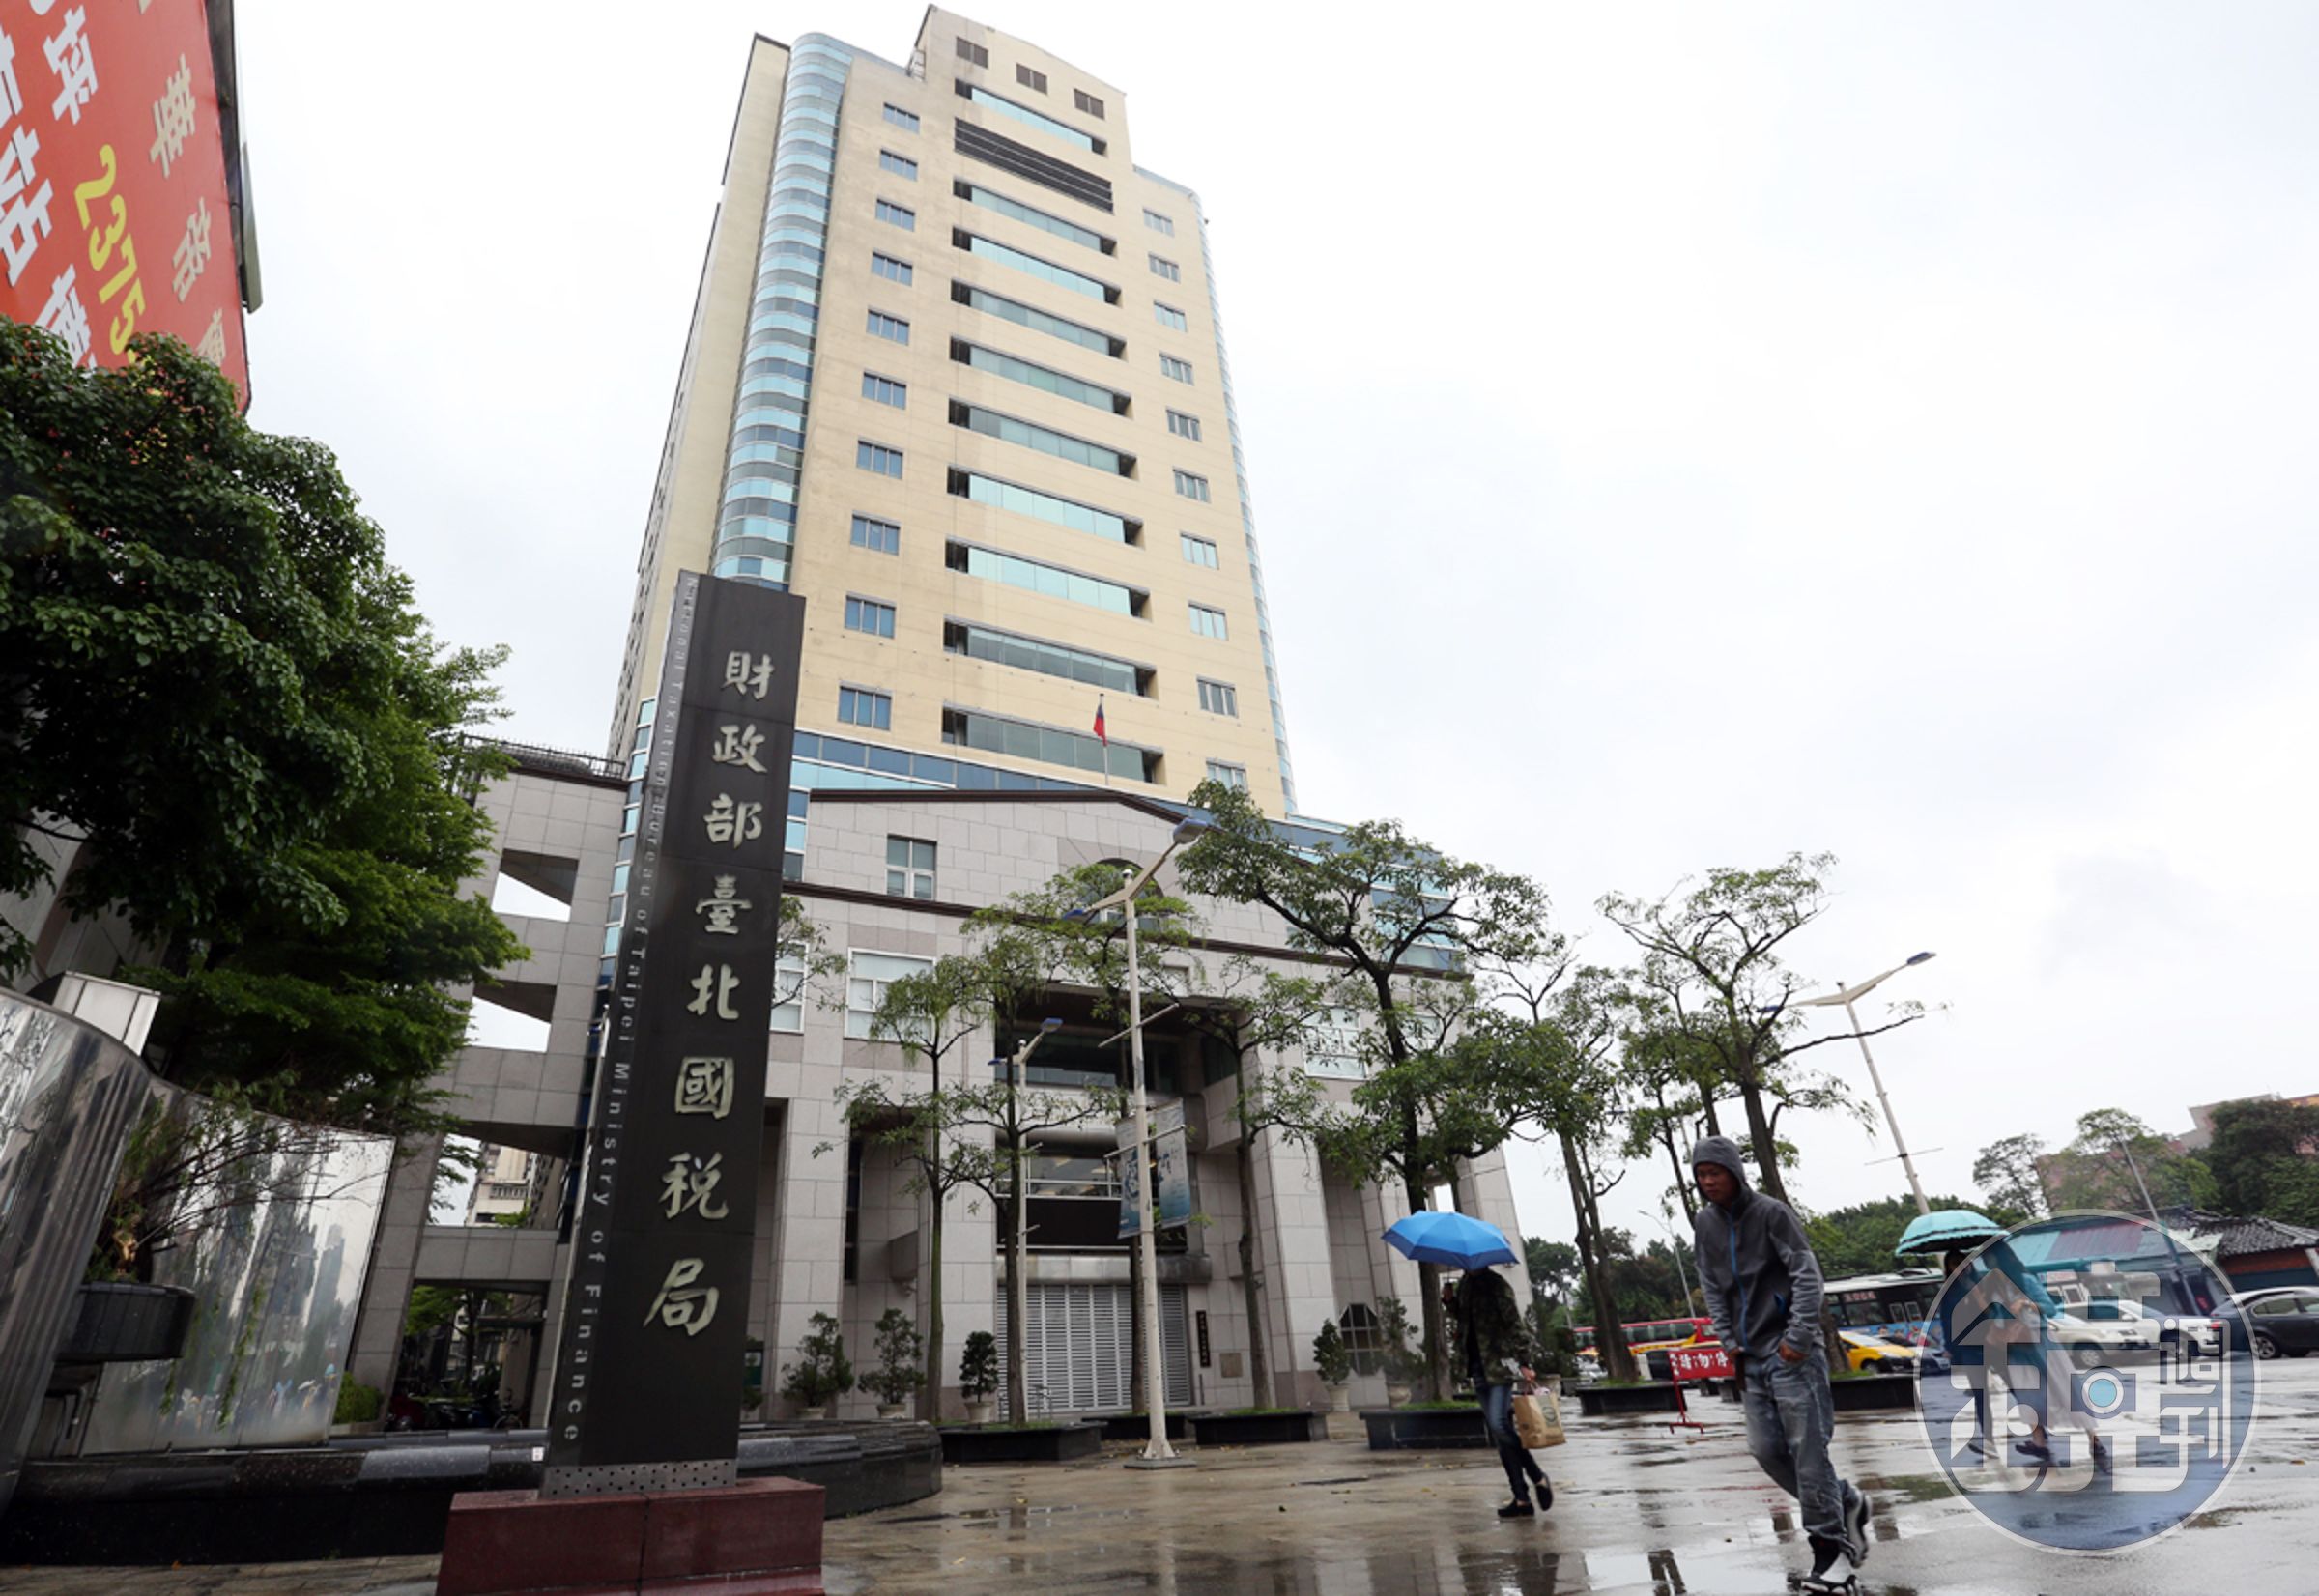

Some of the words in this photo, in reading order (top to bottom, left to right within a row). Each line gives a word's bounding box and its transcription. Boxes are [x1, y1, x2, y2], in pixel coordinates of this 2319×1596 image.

[634, 909, 648, 935] of
[618, 947, 646, 1041] Taipei
[593, 1063, 631, 1206] Ministry
[588, 1230, 606, 1263] of
[564, 1284, 601, 1440] Finance
